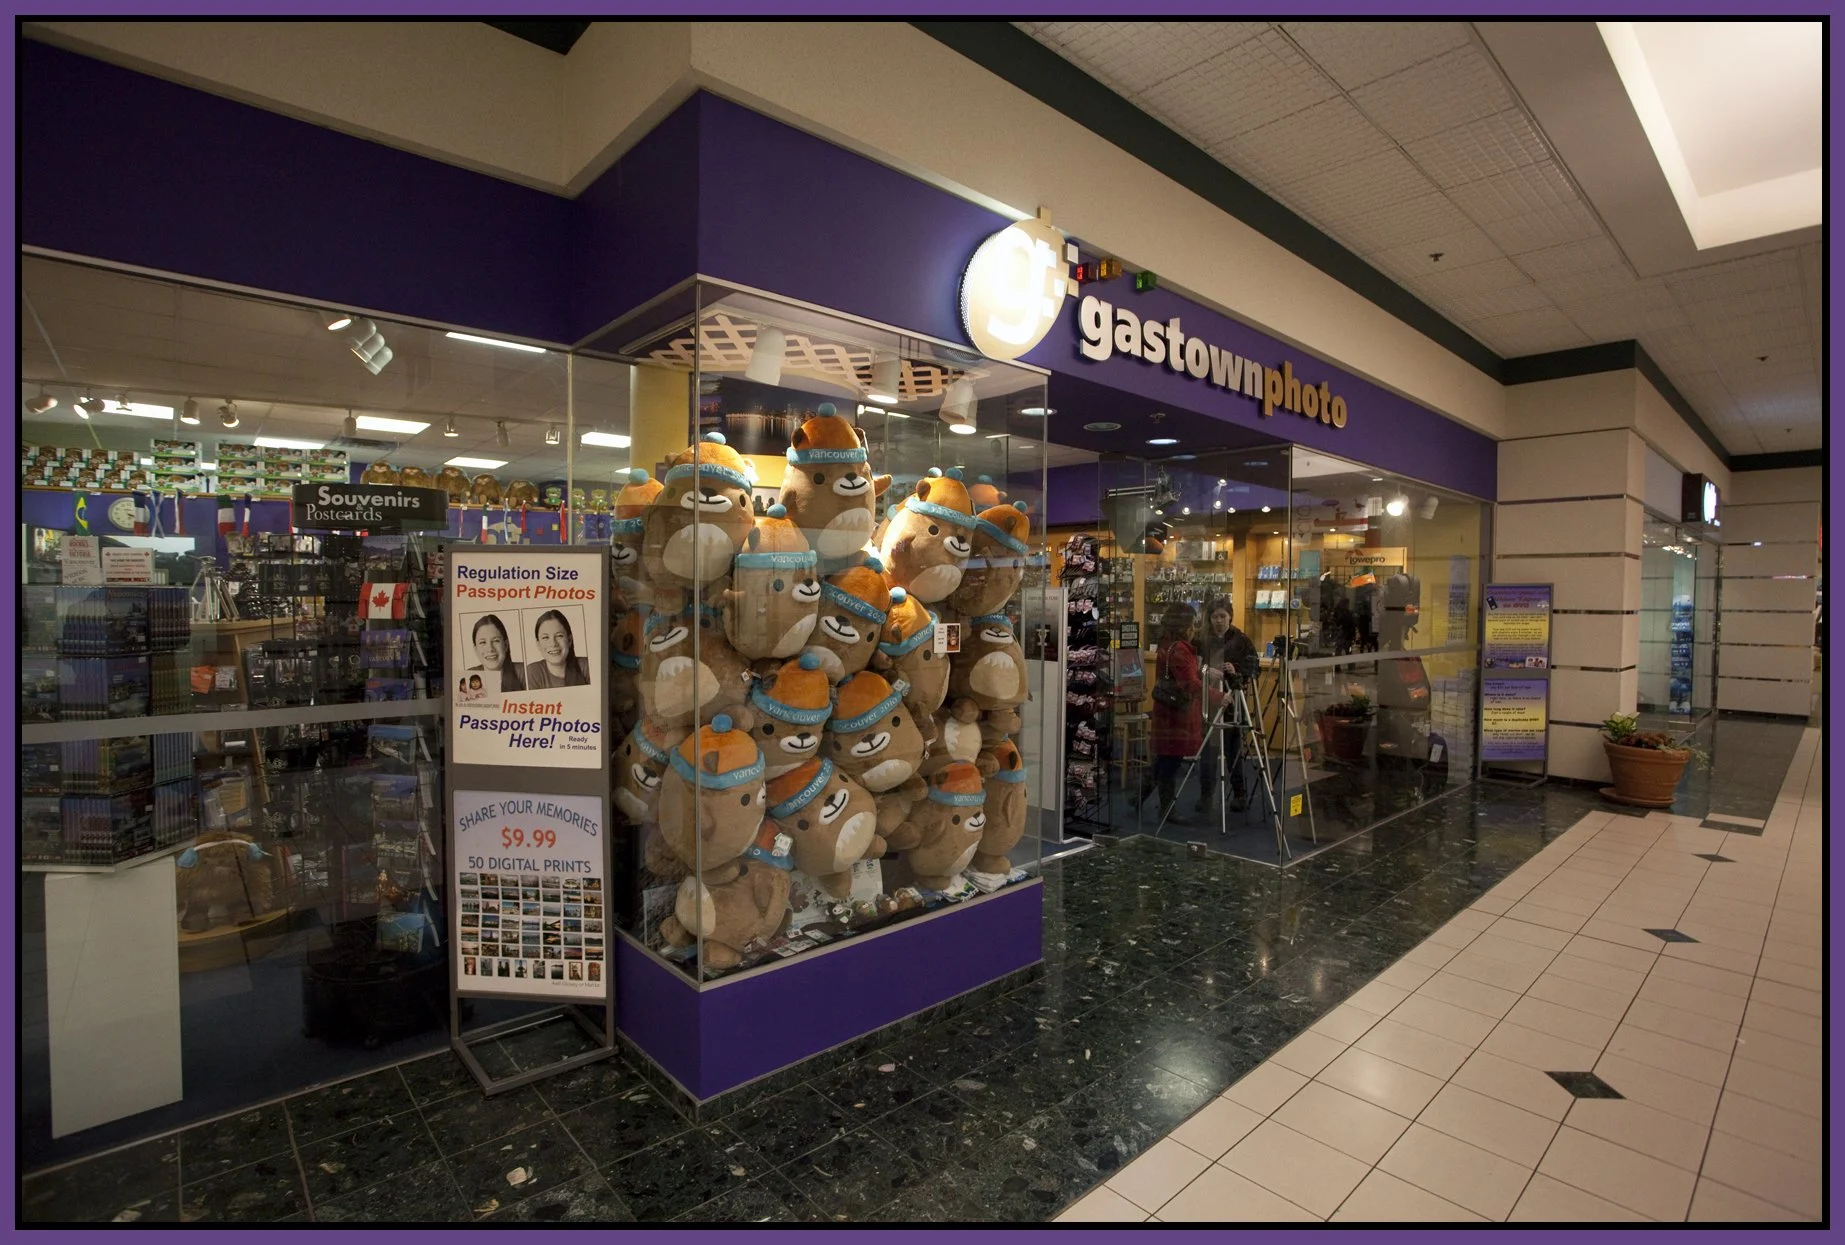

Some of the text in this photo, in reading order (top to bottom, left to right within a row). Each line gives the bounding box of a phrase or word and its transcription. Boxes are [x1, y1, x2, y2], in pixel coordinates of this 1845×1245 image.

[808, 450, 859, 460] vancouver
[318, 485, 420, 508] Souvenirs
[306, 504, 383, 521] Postcards
[355, 503, 364, 511] &
[457, 566, 579, 582] Regulation Size
[456, 584, 596, 601] Passport Photos
[502, 699, 563, 715] Instant
[767, 703, 821, 722] vancouver
[459, 715, 601, 734] Passport Photos
[508, 733, 555, 749] Here!
[568, 735, 588, 744] Ready
[459, 799, 598, 837] SHARE YOUR MEMORIES
[501, 826, 557, 849] $9.99
[468, 856, 592, 873] 50 DIGITAL PRINTS
